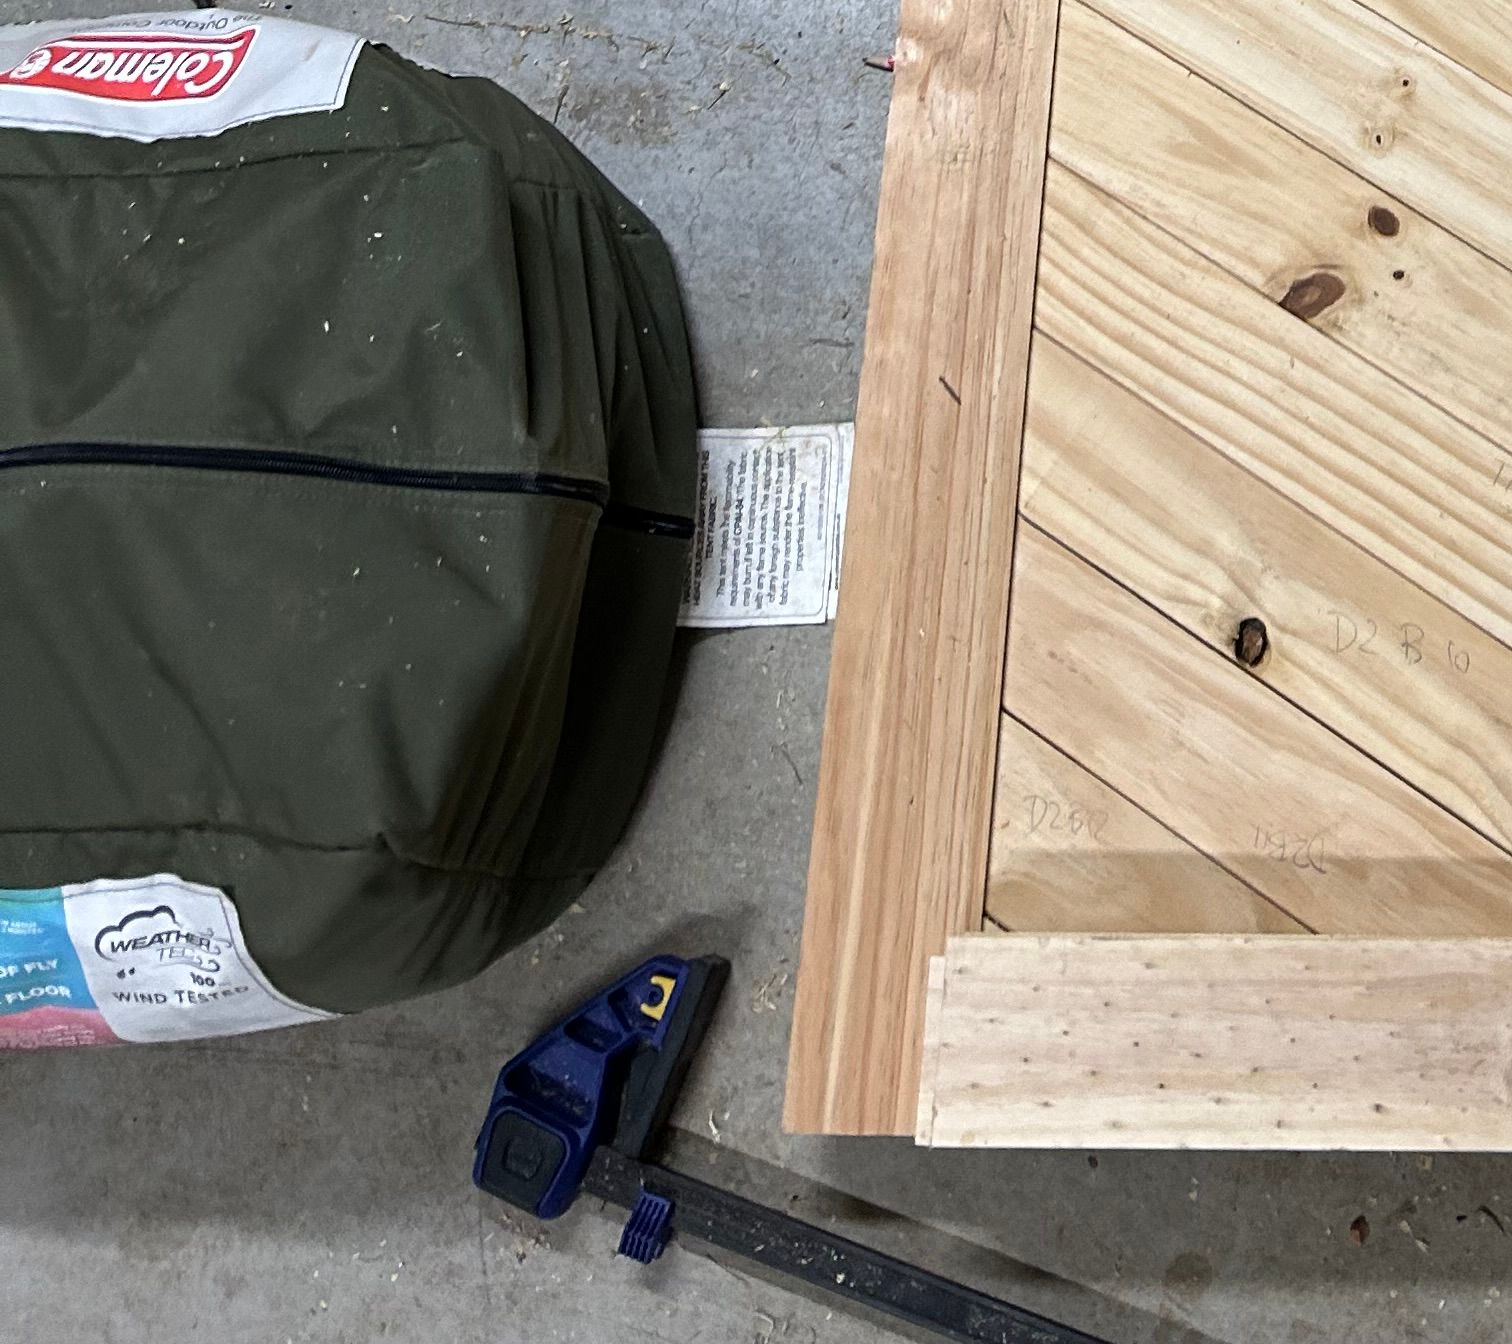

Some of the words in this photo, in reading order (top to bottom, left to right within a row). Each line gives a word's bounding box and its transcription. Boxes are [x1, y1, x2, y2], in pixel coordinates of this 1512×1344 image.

[158, 16, 229, 31] Outdoor
[51, 48, 235, 97] Coleman
[706, 534, 714, 558] TENT
[110, 928, 211, 954] WEATHER
[23, 958, 58, 973] FLY
[4, 984, 72, 1005] FLOOR
[112, 990, 167, 1004] WIND
[174, 984, 250, 1005] TESTED
